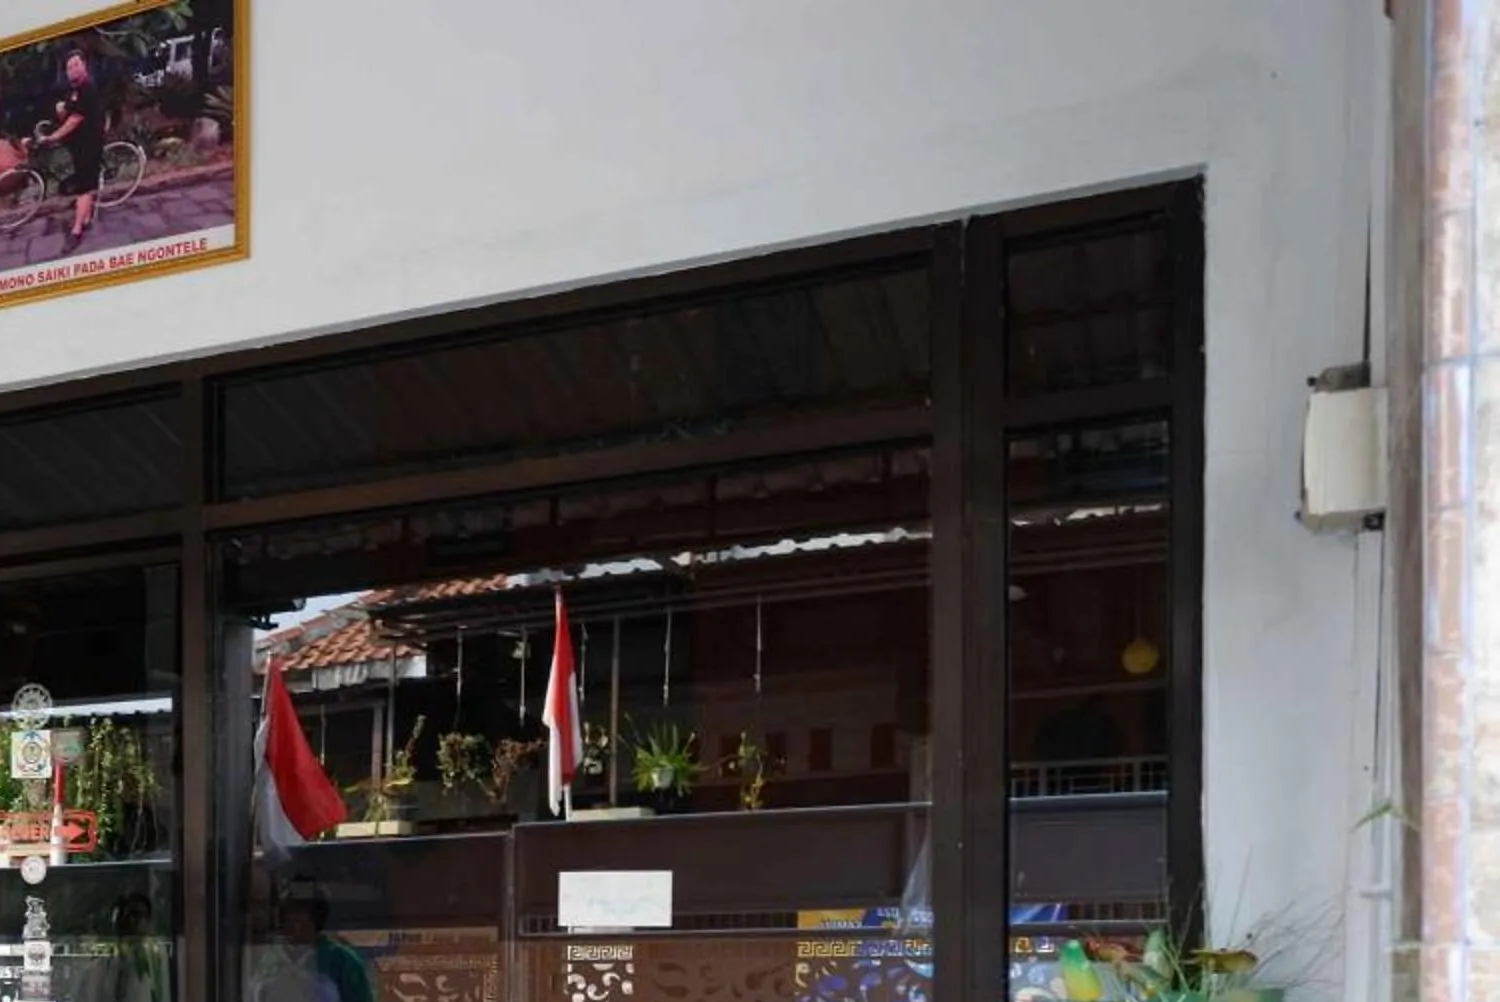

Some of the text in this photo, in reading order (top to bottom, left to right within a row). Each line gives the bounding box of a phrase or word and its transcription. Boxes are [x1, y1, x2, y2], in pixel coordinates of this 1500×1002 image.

[37, 266, 71, 284] SAIKI
[73, 260, 105, 278] PADA
[109, 252, 134, 270] BAE
[137, 237, 207, 263] NGONTELE
